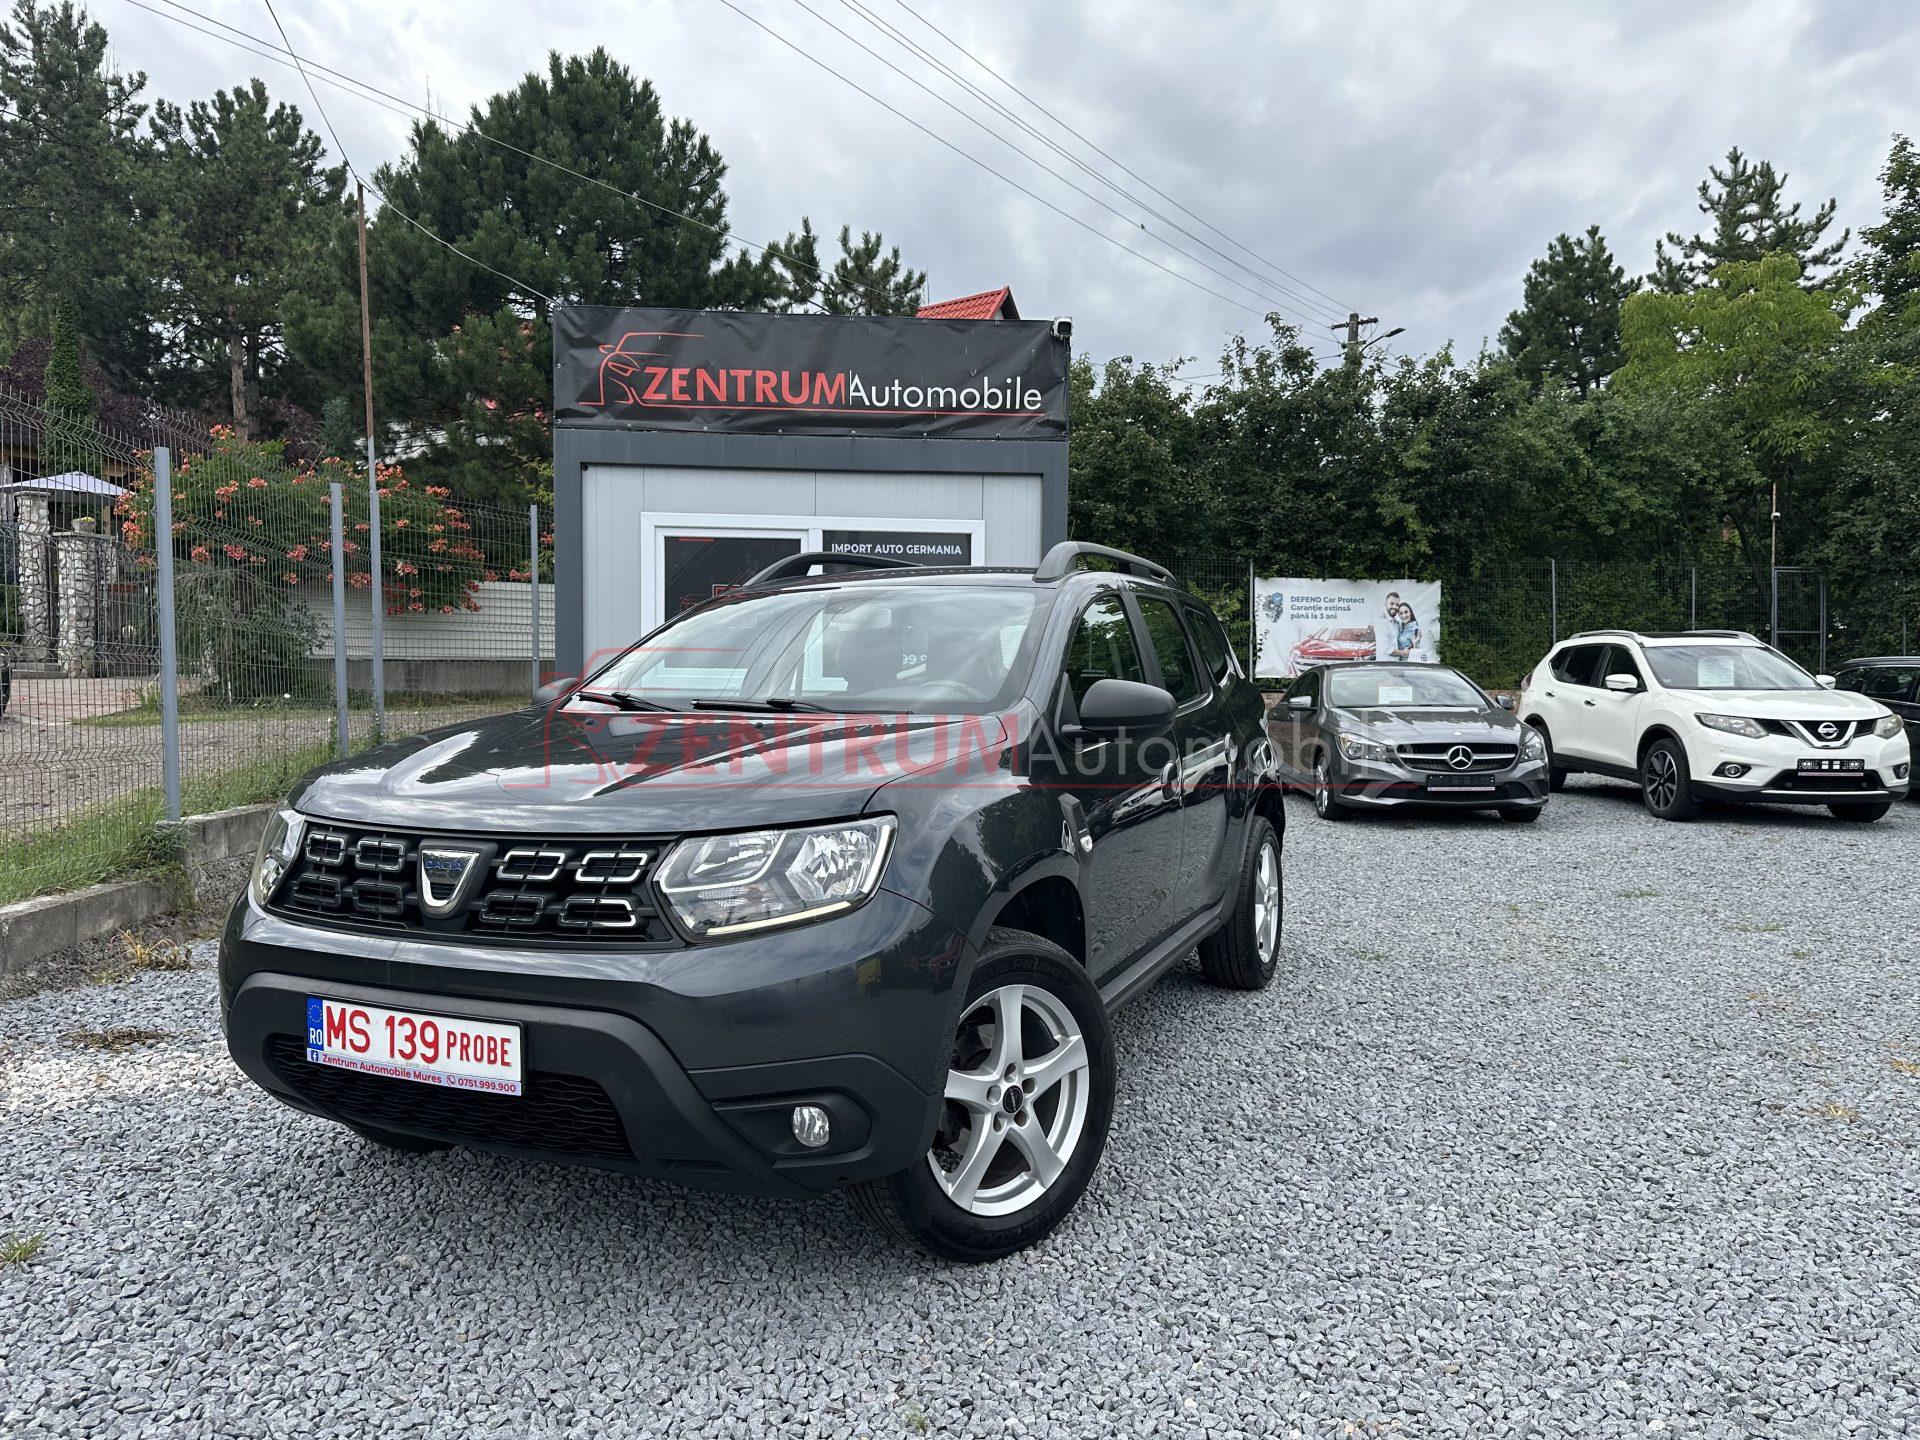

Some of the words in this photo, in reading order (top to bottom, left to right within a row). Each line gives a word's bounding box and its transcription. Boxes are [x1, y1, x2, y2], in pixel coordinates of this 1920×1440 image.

[642, 366, 846, 405] ZENTRUM
[849, 370, 1042, 410] Automobile
[831, 543, 872, 553] IMPORT
[875, 544, 904, 554] AUTO
[906, 544, 962, 555] GERMANIA
[309, 1027, 323, 1045] RO
[326, 1005, 371, 1053] MS
[385, 1015, 439, 1064] 139
[446, 1030, 511, 1067] PROBE
[322, 1053, 358, 1069] Zentrum
[360, 1062, 411, 1078] Automobile
[413, 1070, 442, 1084] Mures
[458, 1078, 516, 1093] 0751.999.900
